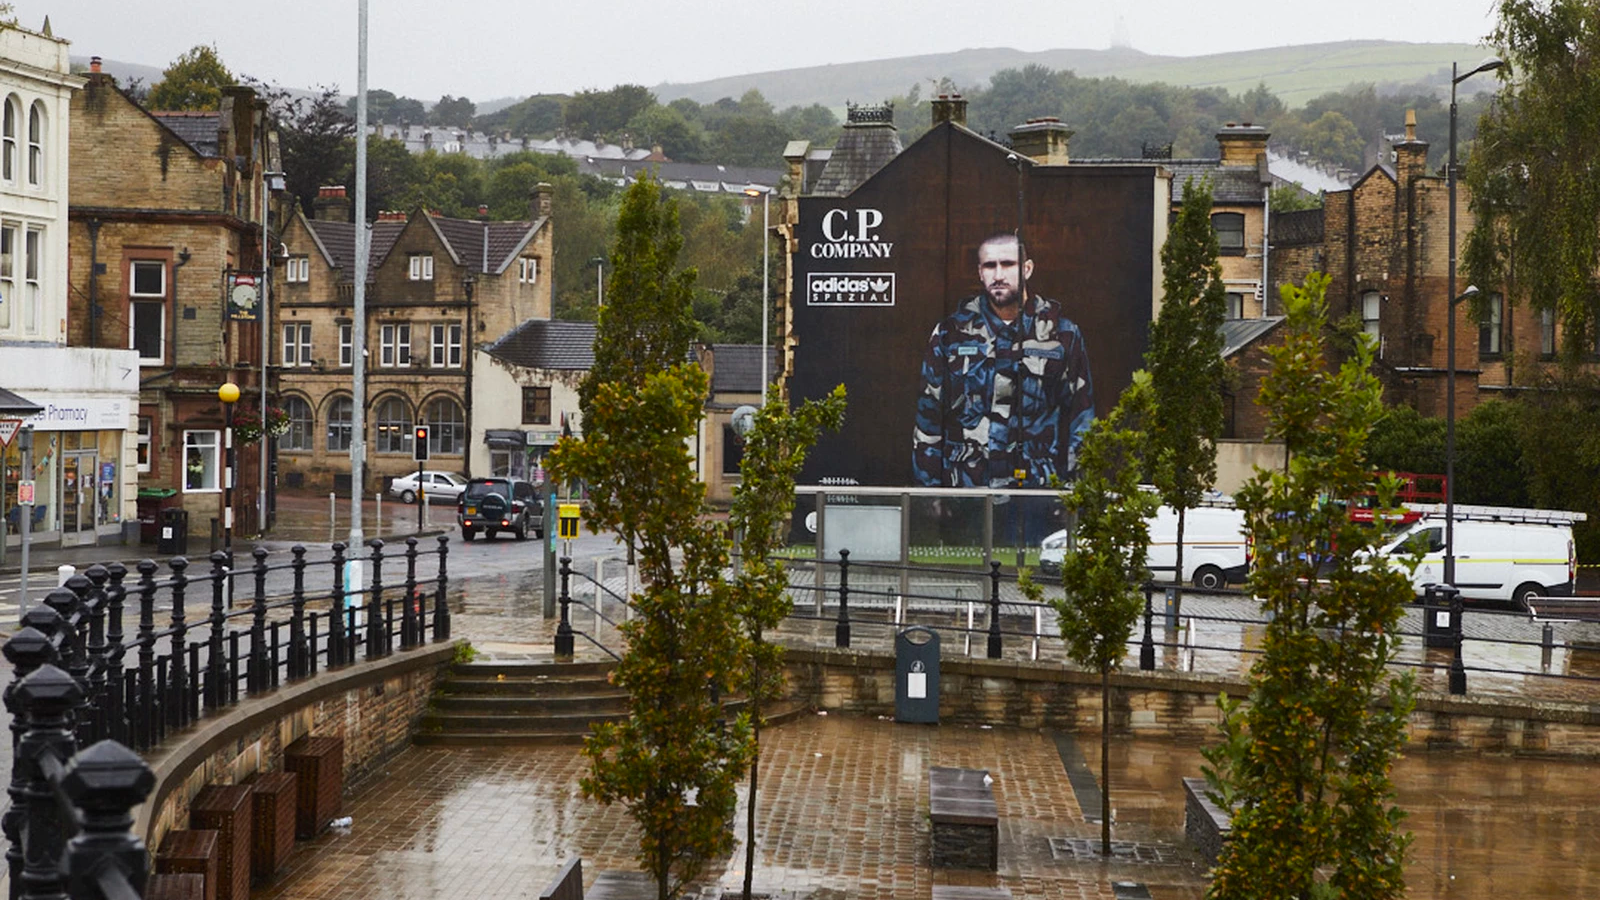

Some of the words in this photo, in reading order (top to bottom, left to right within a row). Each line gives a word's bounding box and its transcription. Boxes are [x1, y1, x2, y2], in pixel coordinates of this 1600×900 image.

[821, 208, 883, 242] C.P.
[810, 242, 893, 258] COMPANY
[811, 277, 869, 292] adidas
[812, 293, 889, 302] SPEZIAL
[48, 404, 88, 424] Pharmacy
